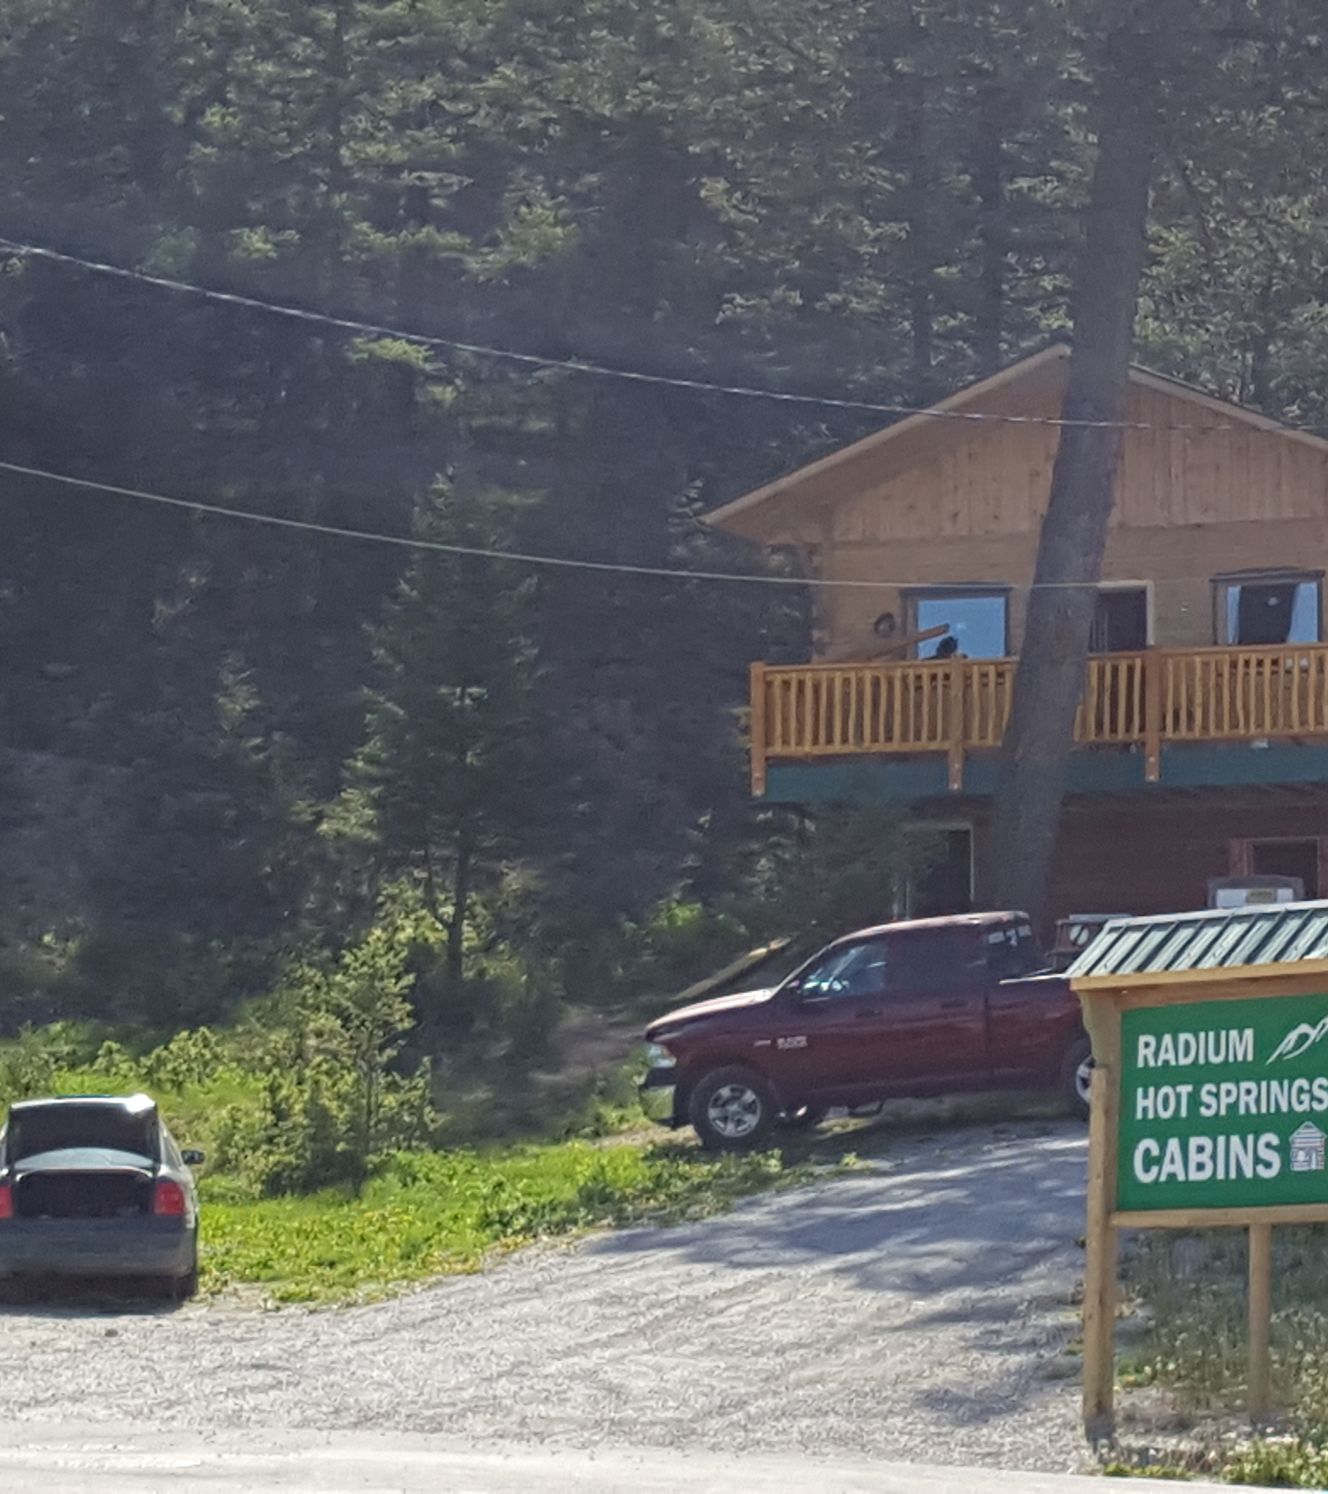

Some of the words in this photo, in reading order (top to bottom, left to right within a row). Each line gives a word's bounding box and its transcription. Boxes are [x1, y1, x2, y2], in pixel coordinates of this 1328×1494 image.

[1137, 1028, 1254, 1068] RADIUM
[1136, 1084, 1193, 1120] HOT
[1133, 1132, 1281, 1183] CABINS
